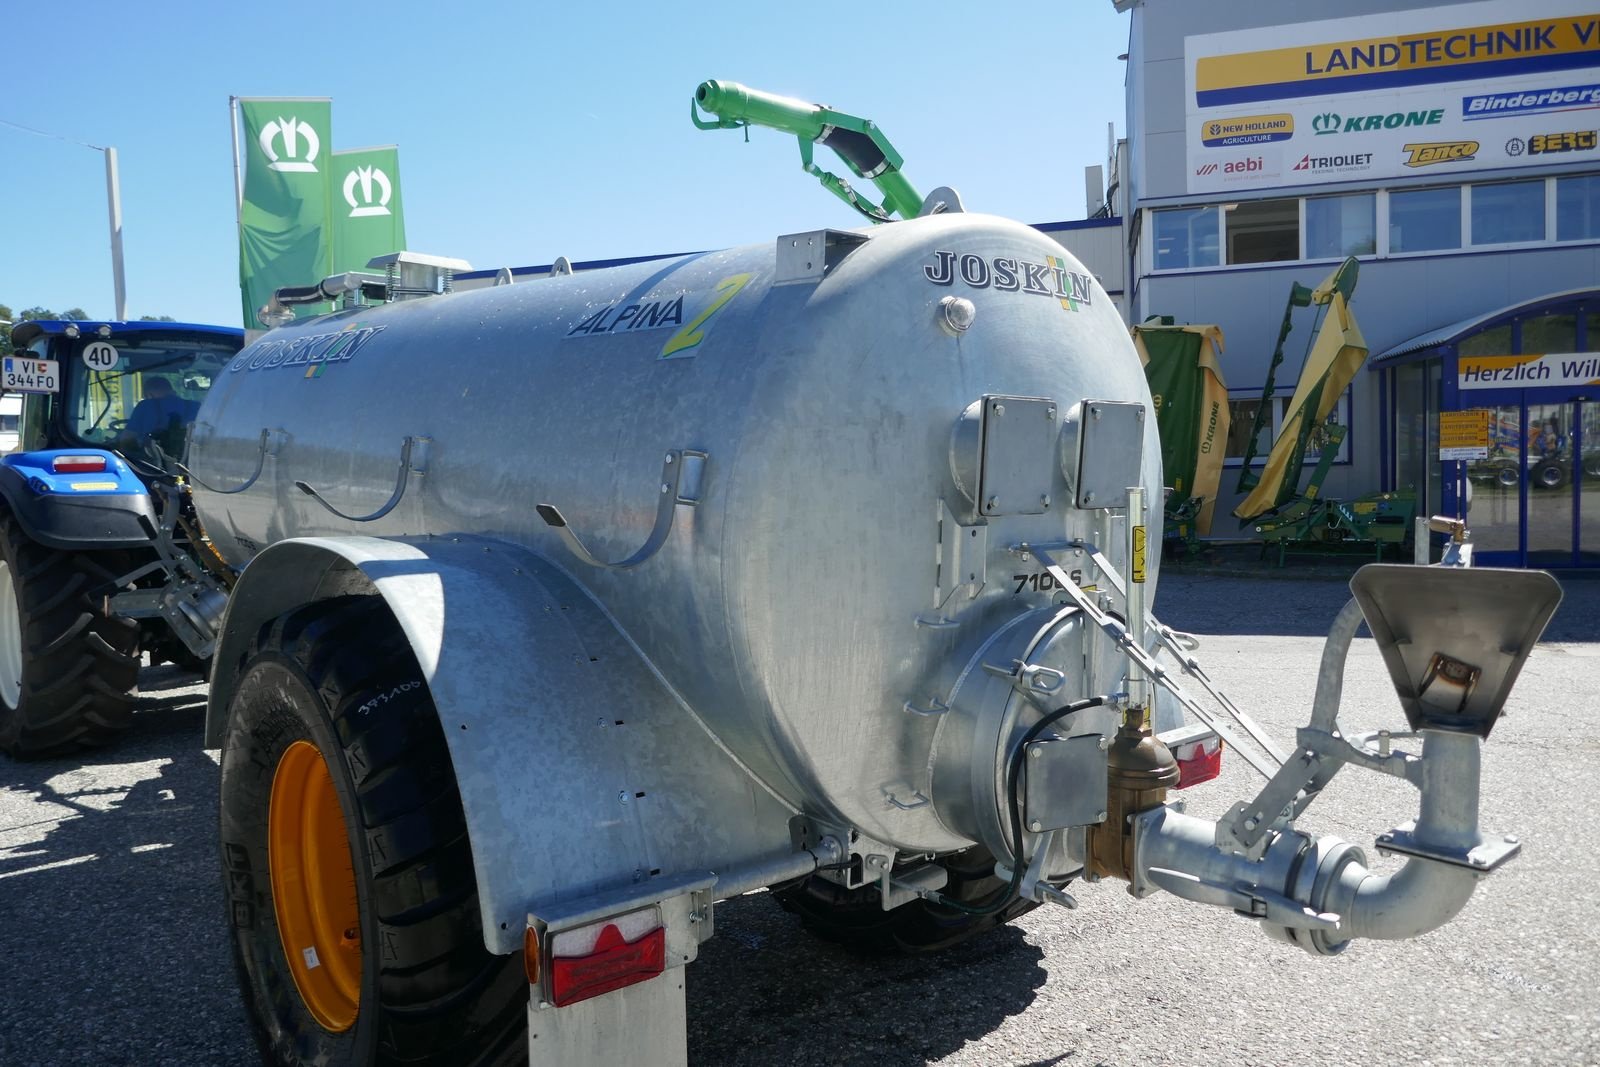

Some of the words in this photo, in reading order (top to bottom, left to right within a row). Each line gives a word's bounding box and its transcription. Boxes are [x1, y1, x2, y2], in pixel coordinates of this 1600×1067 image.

[1306, 25, 1557, 75] LANDTECHNIK
[1223, 124, 1243, 134] NEW
[1246, 120, 1286, 131] HOLLAND
[1343, 108, 1445, 133] KRONE
[1223, 134, 1271, 145] AGRICULTURE
[1224, 156, 1263, 174] aebi
[1310, 153, 1373, 169] TRIOLIET
[1403, 141, 1479, 167] Tanco
[924, 250, 1092, 305] JOSKIN
[567, 295, 684, 337] ALPINA
[662, 272, 753, 358] 2
[89, 347, 112, 366] 40
[230, 325, 388, 373] JOSKIN
[22, 361, 35, 374] VI
[1464, 361, 1551, 382] Herzlich
[1207, 400, 1220, 443] KRONE
